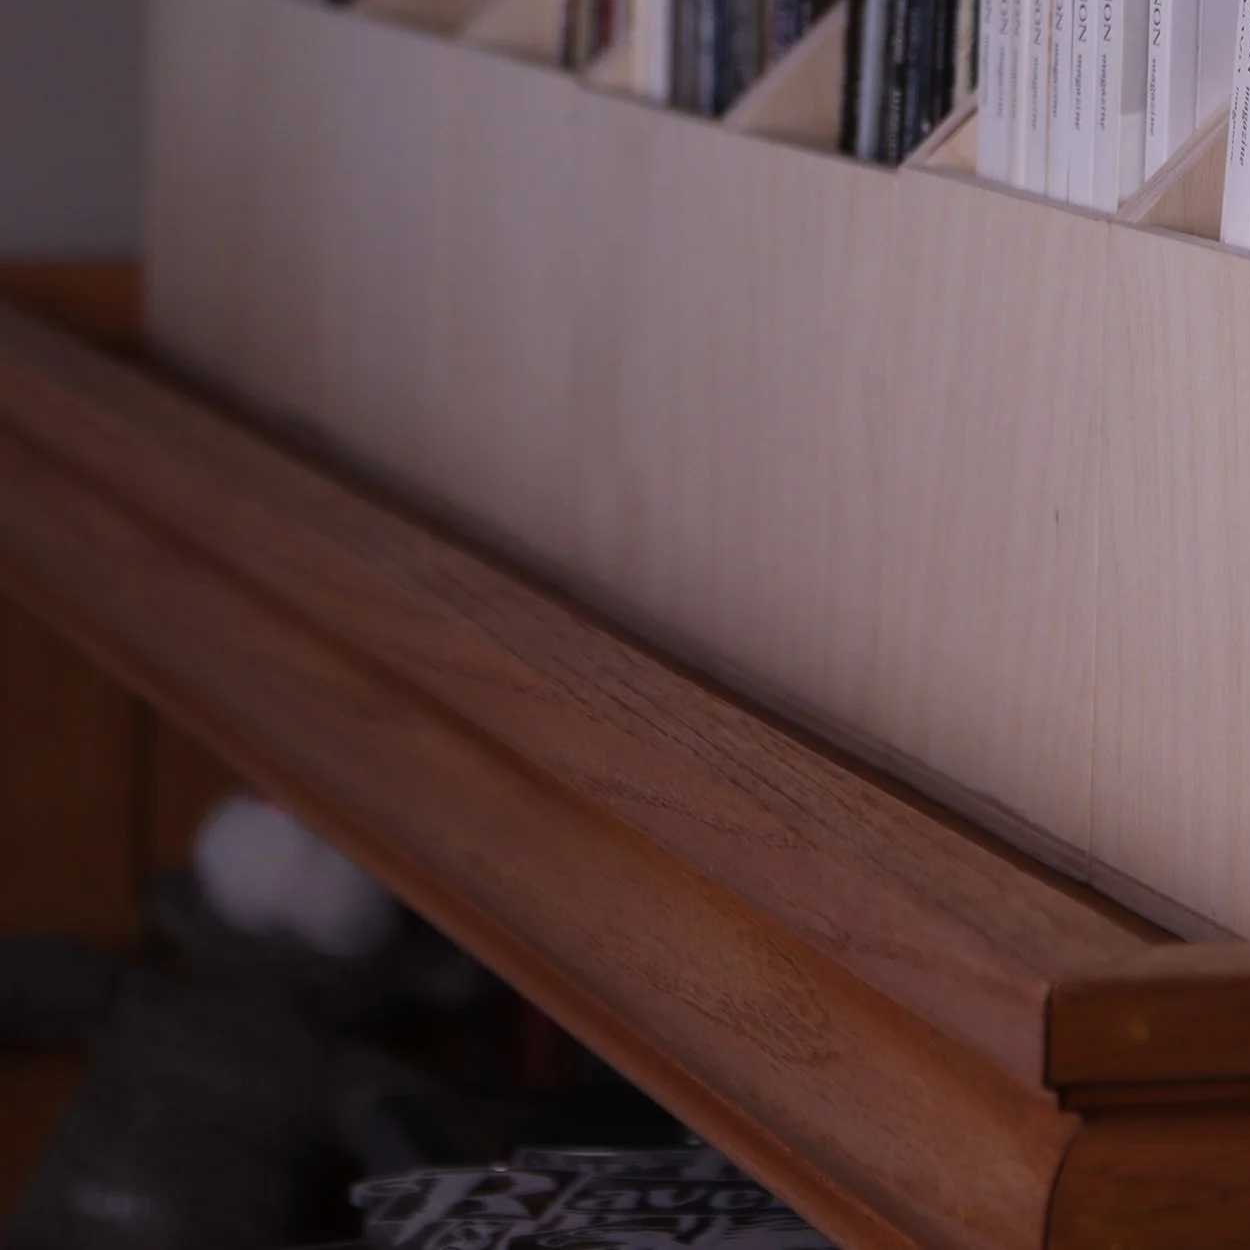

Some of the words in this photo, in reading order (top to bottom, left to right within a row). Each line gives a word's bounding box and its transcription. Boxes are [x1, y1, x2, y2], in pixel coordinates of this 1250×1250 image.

[1074, 54, 1082, 130] magazine
[1099, 54, 1107, 130] magazine
[1239, 86, 1250, 166] magazine
